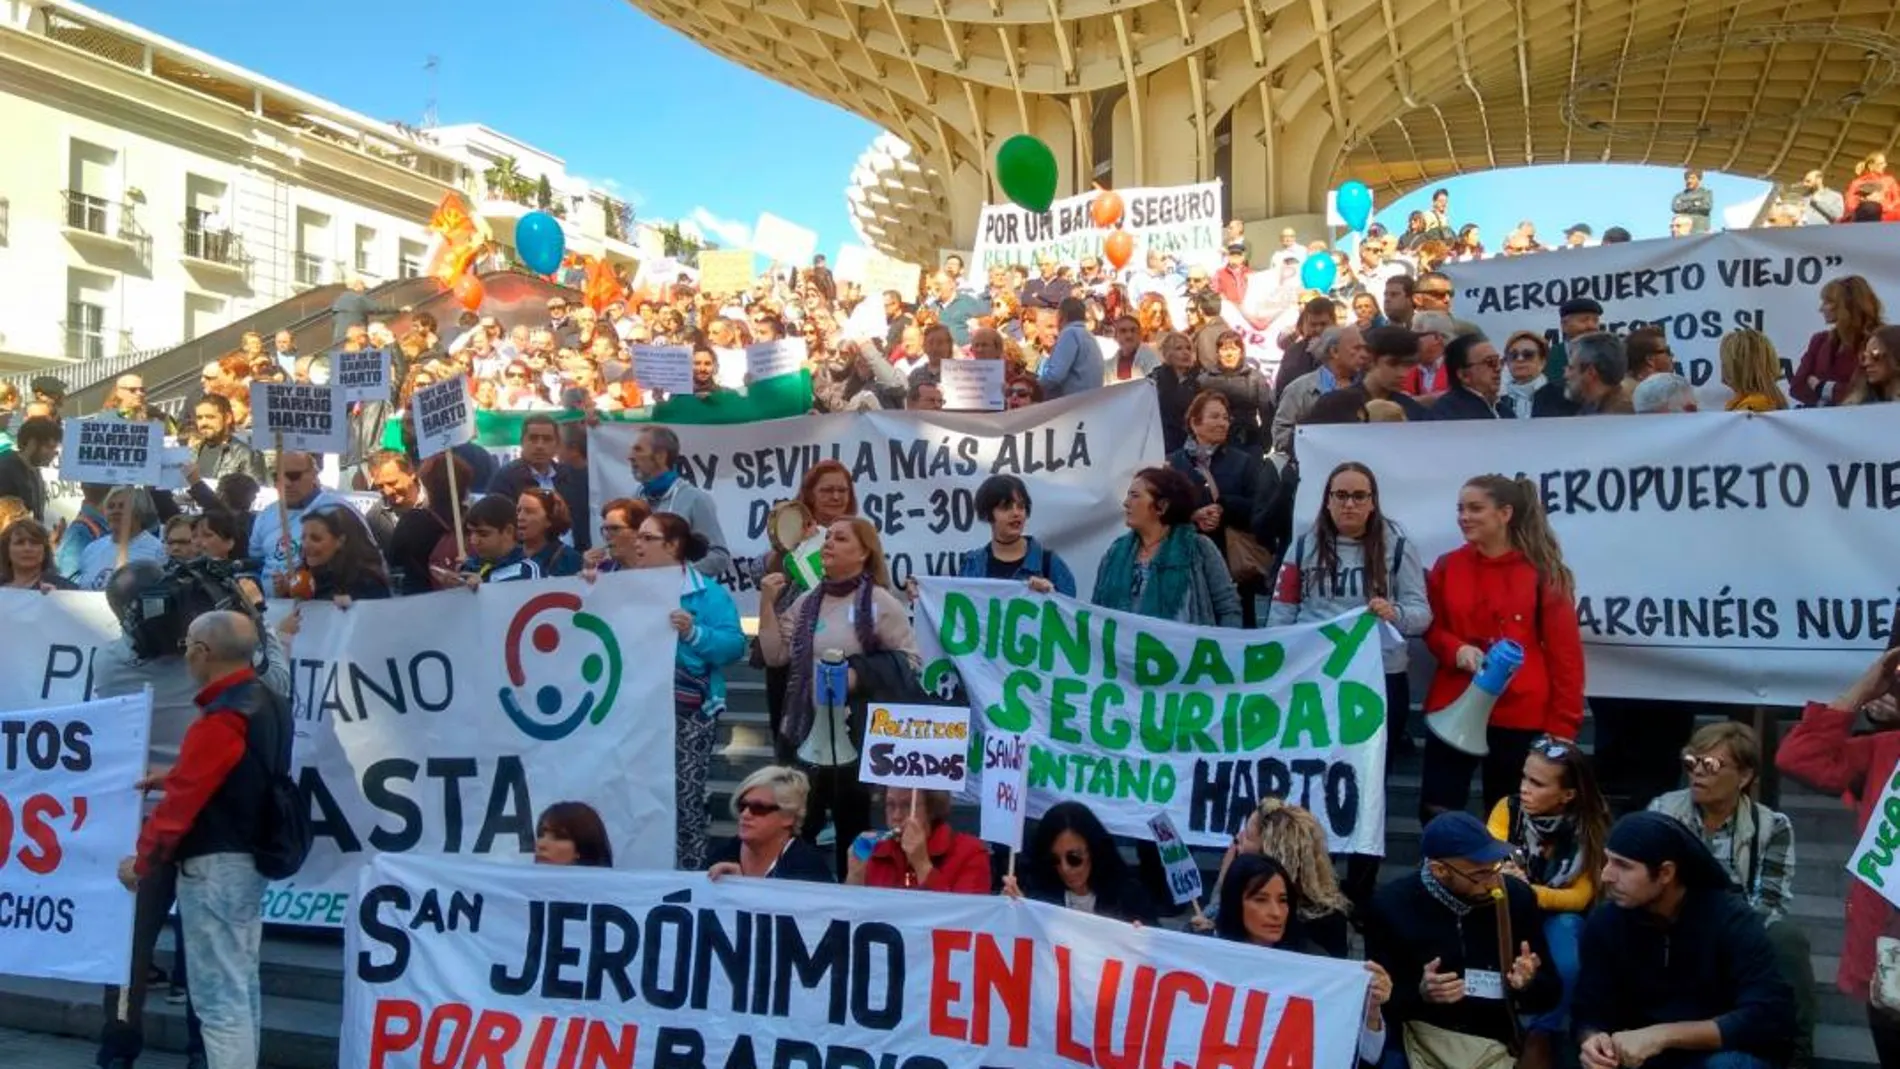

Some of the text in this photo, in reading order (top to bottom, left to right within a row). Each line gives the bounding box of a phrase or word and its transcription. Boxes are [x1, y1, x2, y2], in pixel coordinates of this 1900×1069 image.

[986, 213, 1019, 244] POR
[1131, 189, 1216, 229] SEGURO
[267, 385, 293, 396] SOY
[296, 386, 311, 397] DE
[268, 395, 332, 413] BARRIO
[339, 370, 382, 385] HARTO
[80, 433, 149, 448] BARRIO
[81, 423, 149, 435] SOY DE UN
[268, 411, 332, 430] HARTO
[422, 402, 466, 433] HARTO
[78, 446, 149, 463] HARTO
[676, 453, 719, 490] AY
[887, 435, 979, 482] MÁS
[989, 421, 1093, 475] ALLÁ
[1517, 462, 1810, 515] EROPUERTO
[939, 591, 1378, 687] DIGNIDAD Y
[1576, 585, 1779, 640] ARGINÉIS
[986, 670, 1385, 754] SEGURIDAD
[299, 755, 536, 854] ASTA
[357, 884, 1317, 1069] SAN JERÓNIMO EN LUCHA
[369, 998, 523, 1069] POR
